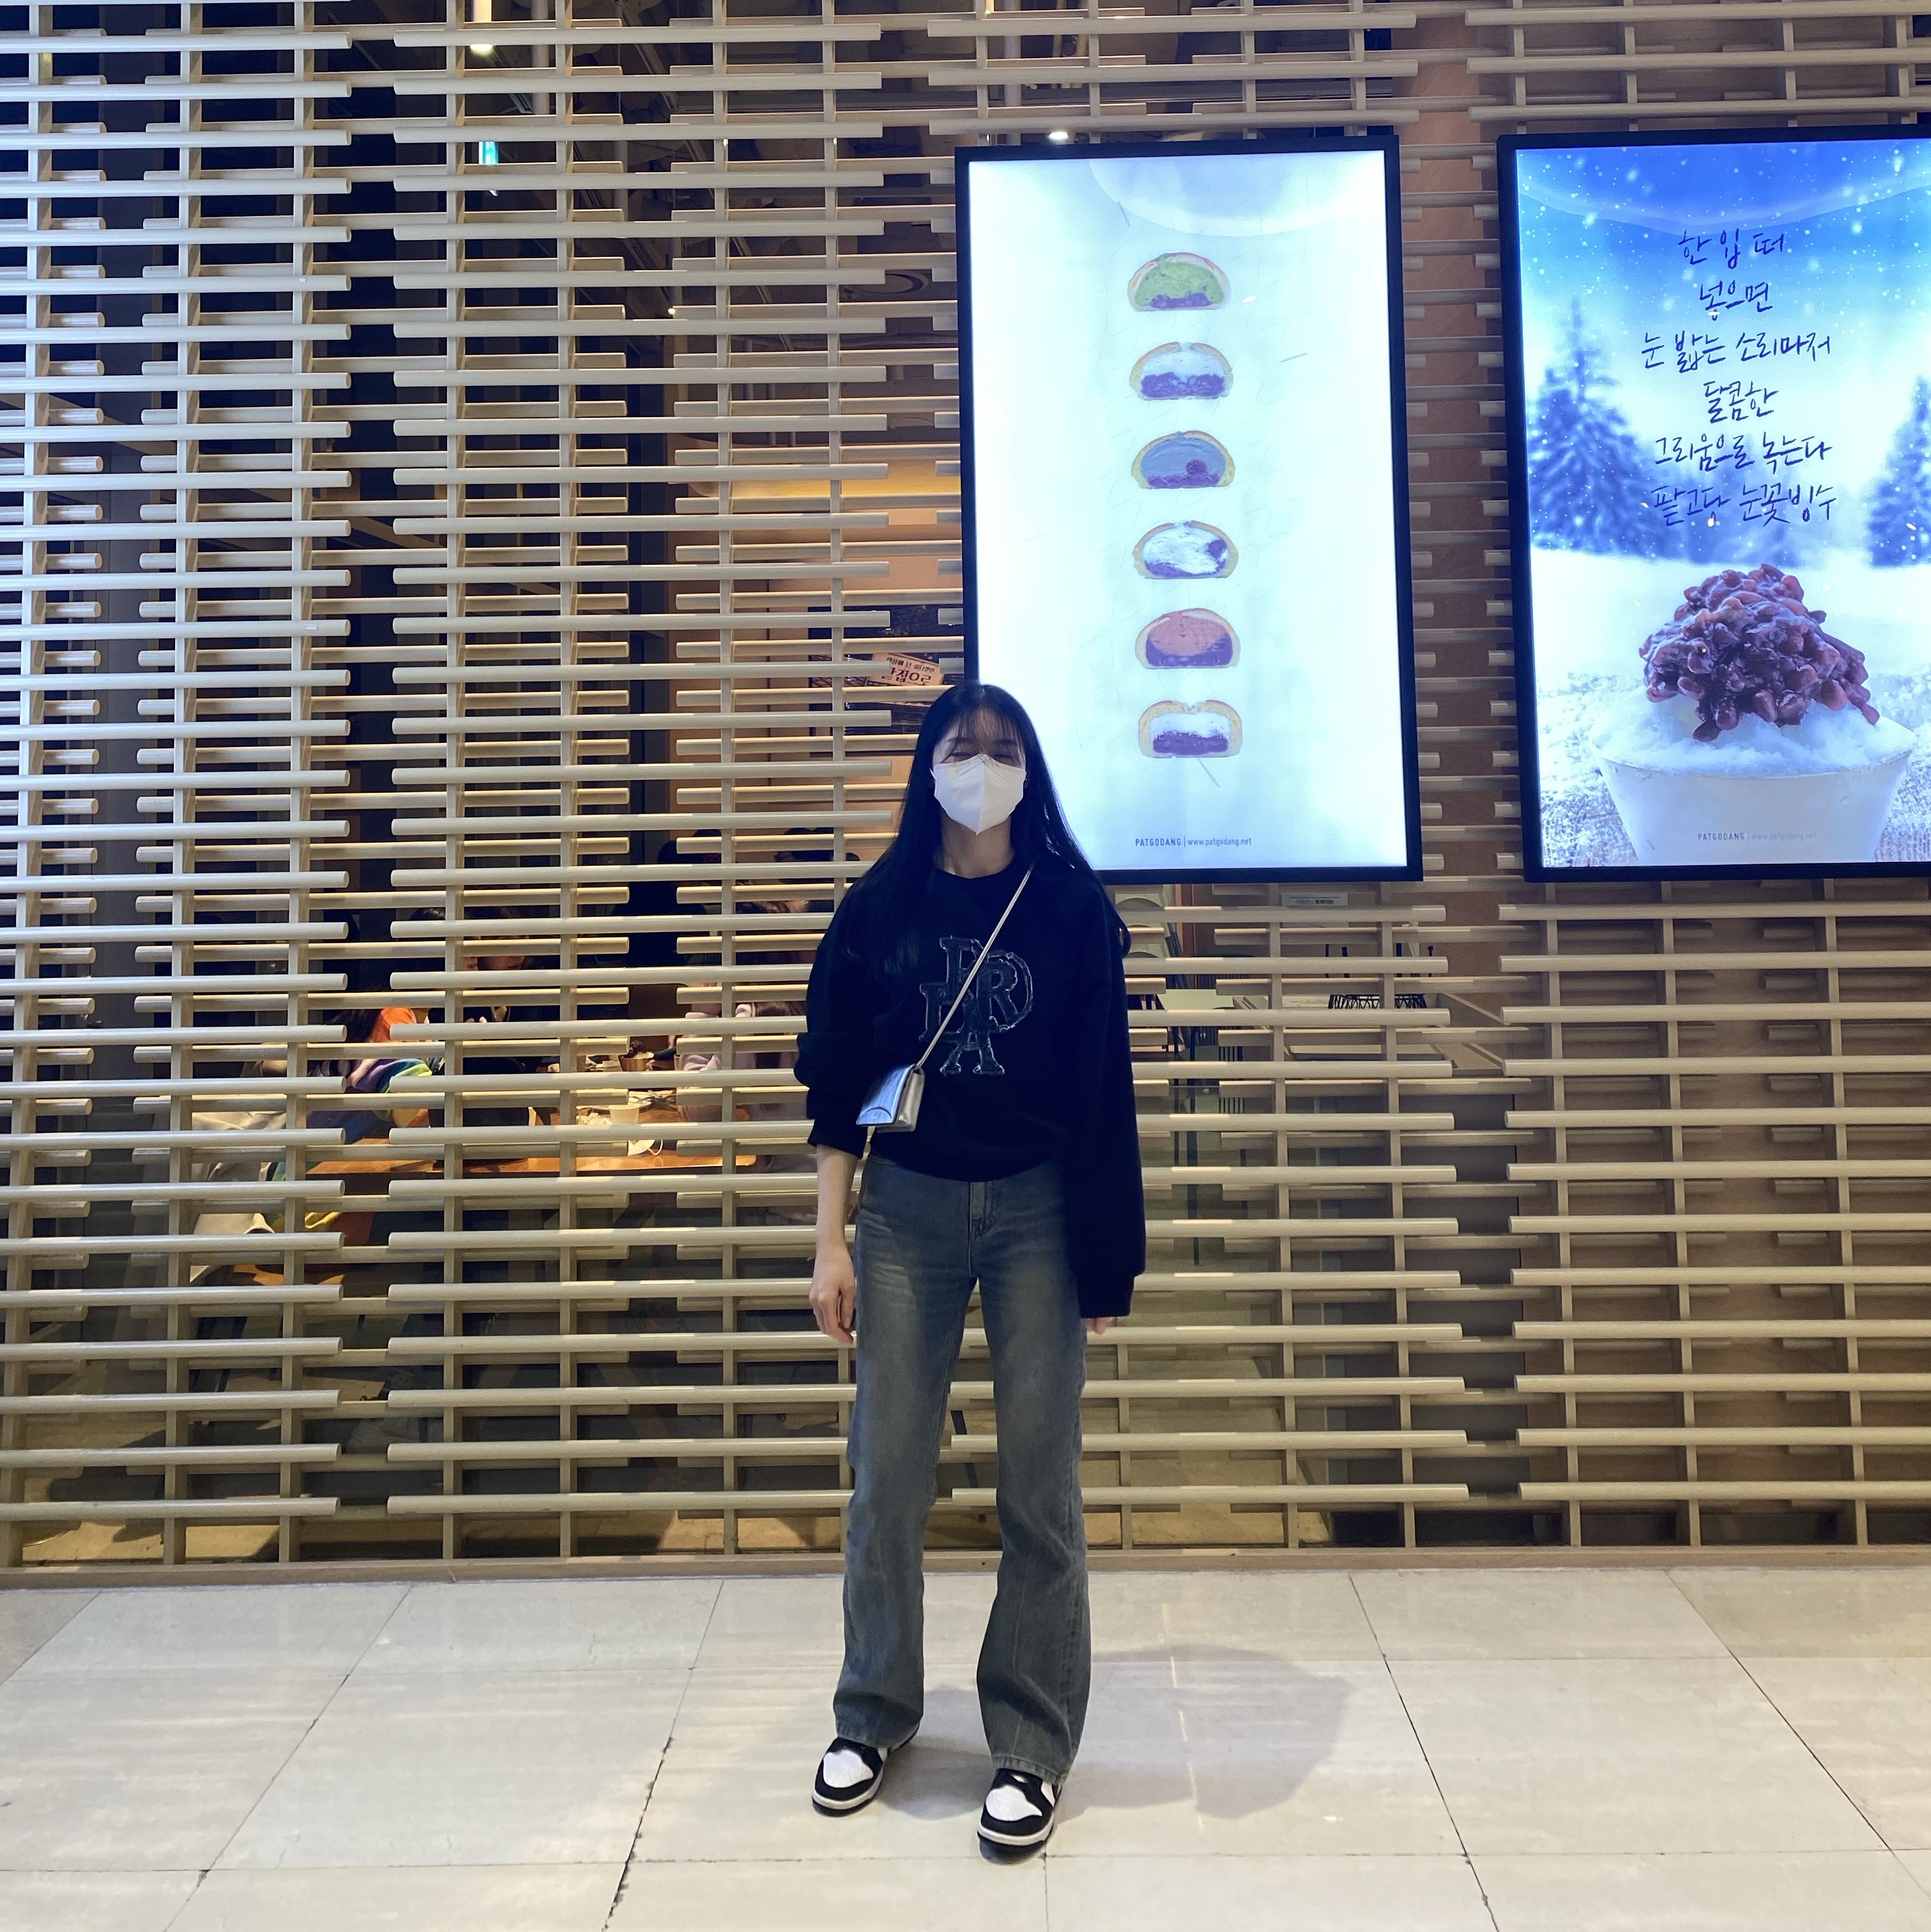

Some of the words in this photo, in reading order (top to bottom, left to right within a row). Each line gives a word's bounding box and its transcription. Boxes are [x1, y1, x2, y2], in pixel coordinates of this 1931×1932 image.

[1679, 229, 1712, 264] 한
[1720, 227, 1742, 270] 입
[1752, 232, 1785, 256] 떠
[1698, 280, 1774, 321] 넣으면
[1642, 332, 1665, 369] 눈
[1675, 330, 1726, 373] 밟는
[1736, 332, 1831, 362] 소리마저
[1704, 381, 1779, 424] 달콤한
[1655, 433, 1754, 473] 그리움으로
[1762, 431, 1833, 474] 녹는다
[1651, 485, 1731, 527] 팥고당
[1739, 482, 1837, 526] 눈꽃빙수
[1135, 838, 1182, 847] PATGODANG
[1187, 837, 1252, 848] www.patgodang.net
[1697, 832, 1745, 841] PATGODANG
